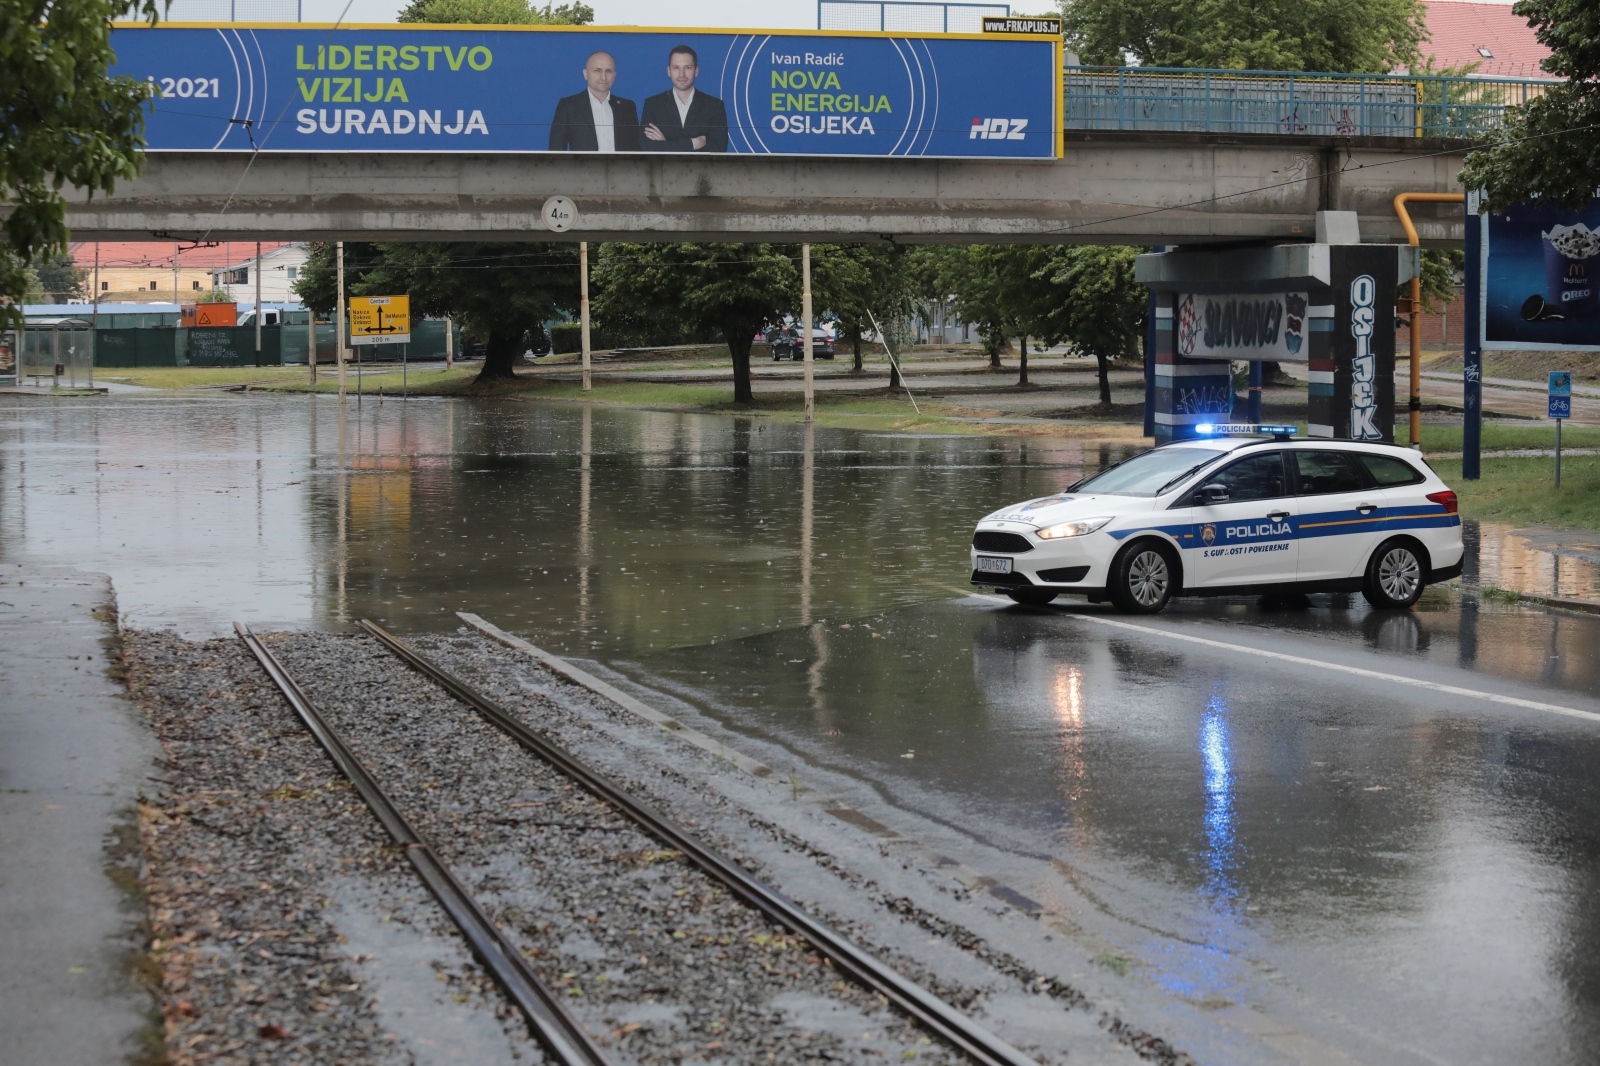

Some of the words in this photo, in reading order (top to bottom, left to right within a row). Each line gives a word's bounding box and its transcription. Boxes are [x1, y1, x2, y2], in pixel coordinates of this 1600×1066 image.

[985, 20, 1058, 33] www.FRKAPLUS.hr
[296, 46, 492, 70] LIDERSTVO
[772, 52, 800, 65] Ivan
[805, 52, 844, 66] Radić
[161, 78, 220, 98] 2021
[297, 78, 408, 102] VIZIJA
[772, 71, 841, 90] NOVA
[772, 93, 892, 113] ENERGIJA
[296, 110, 489, 136] SURADNJA
[771, 114, 876, 134] OSIJEKA
[969, 118, 1028, 140] HDZ
[1562, 290, 1590, 301] OREO
[1350, 274, 1382, 439] OSIJEK
[1226, 522, 1292, 538] POLICIJA
